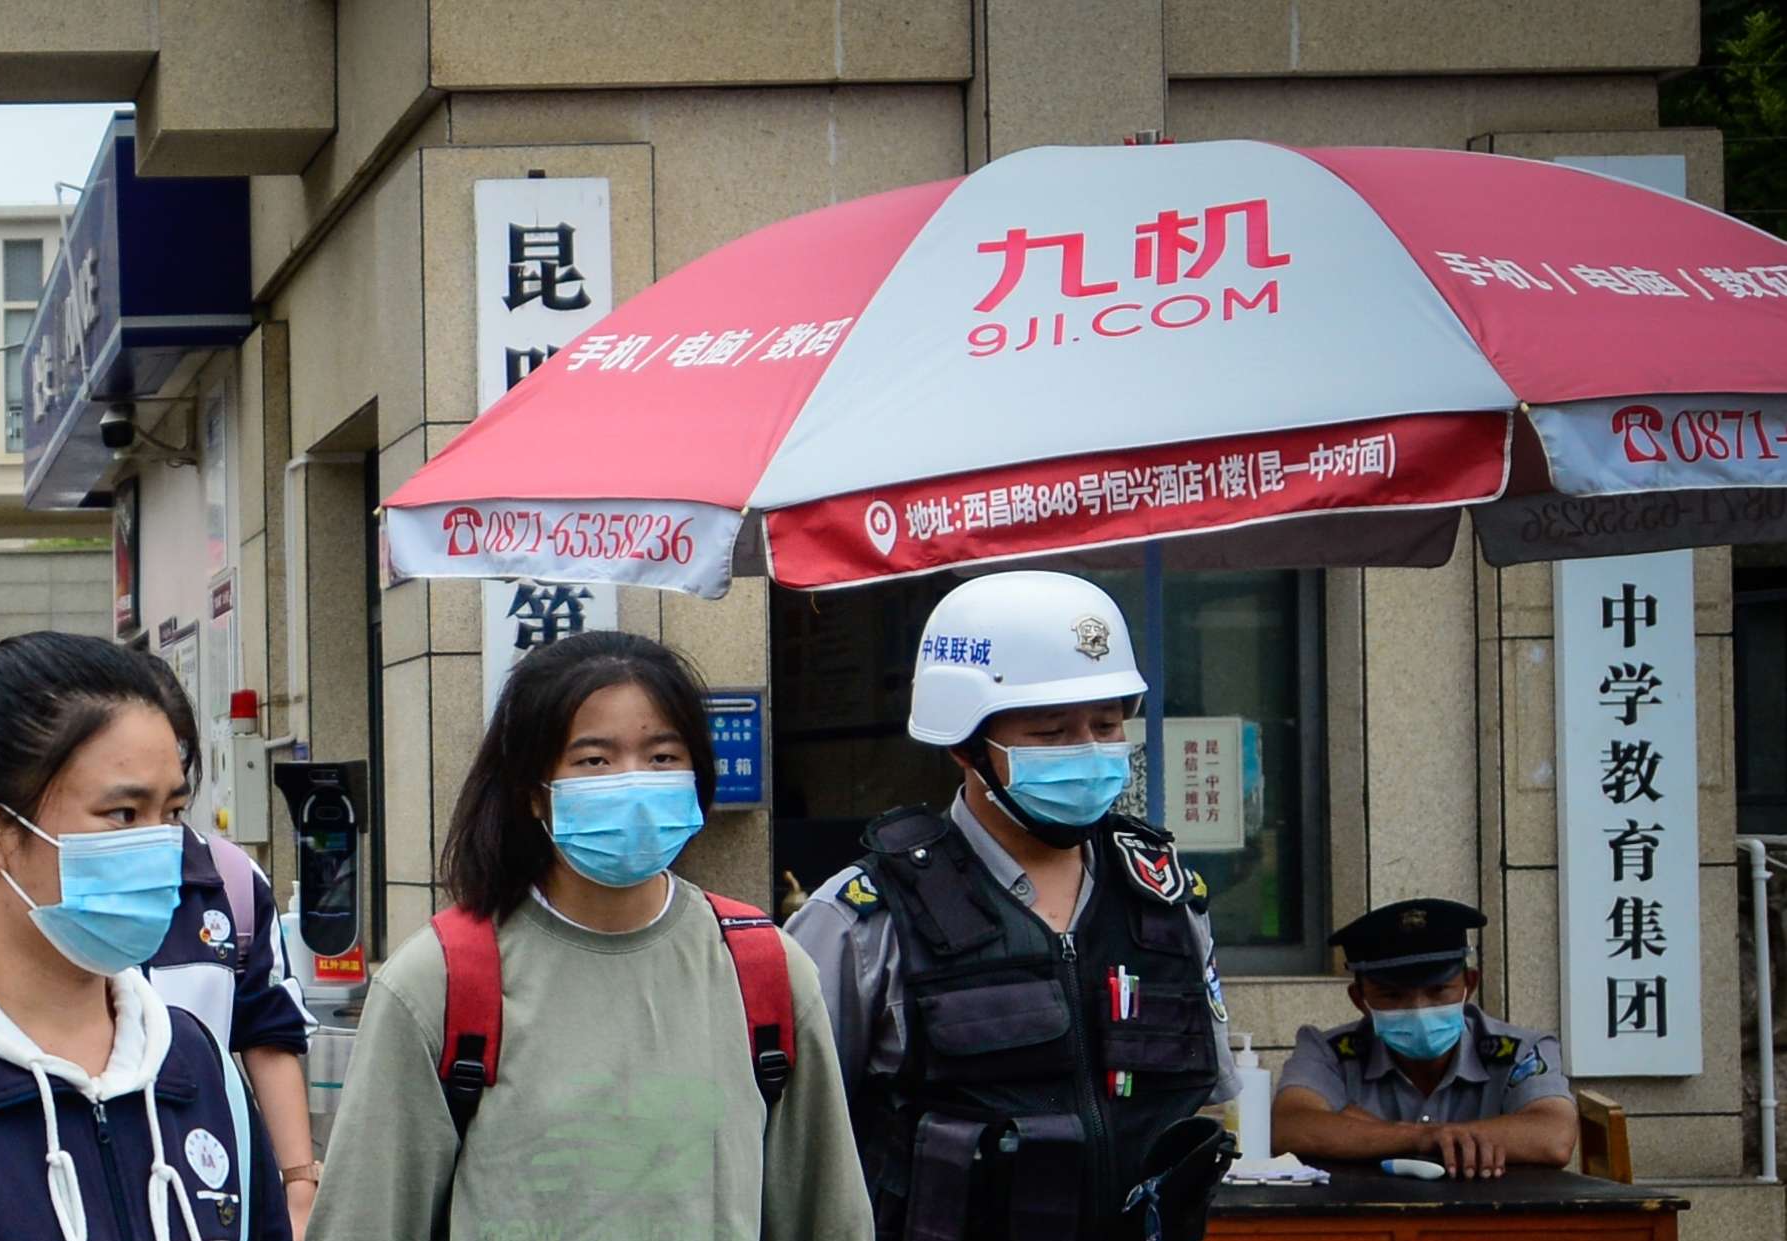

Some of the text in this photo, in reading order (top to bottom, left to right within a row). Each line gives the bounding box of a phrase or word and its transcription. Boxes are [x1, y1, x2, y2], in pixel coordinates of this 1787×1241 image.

[973, 198, 1291, 313] 九机
[967, 280, 1279, 357] 9JI.COM
[484, 511, 694, 565] 0871-65358236
[922, 635, 991, 666] 中保联诚
[1184, 740, 1200, 823] 微信二维码
[1205, 739, 1220, 823] 昆一中官方
[1599, 583, 1668, 1039] 中学教育集团
